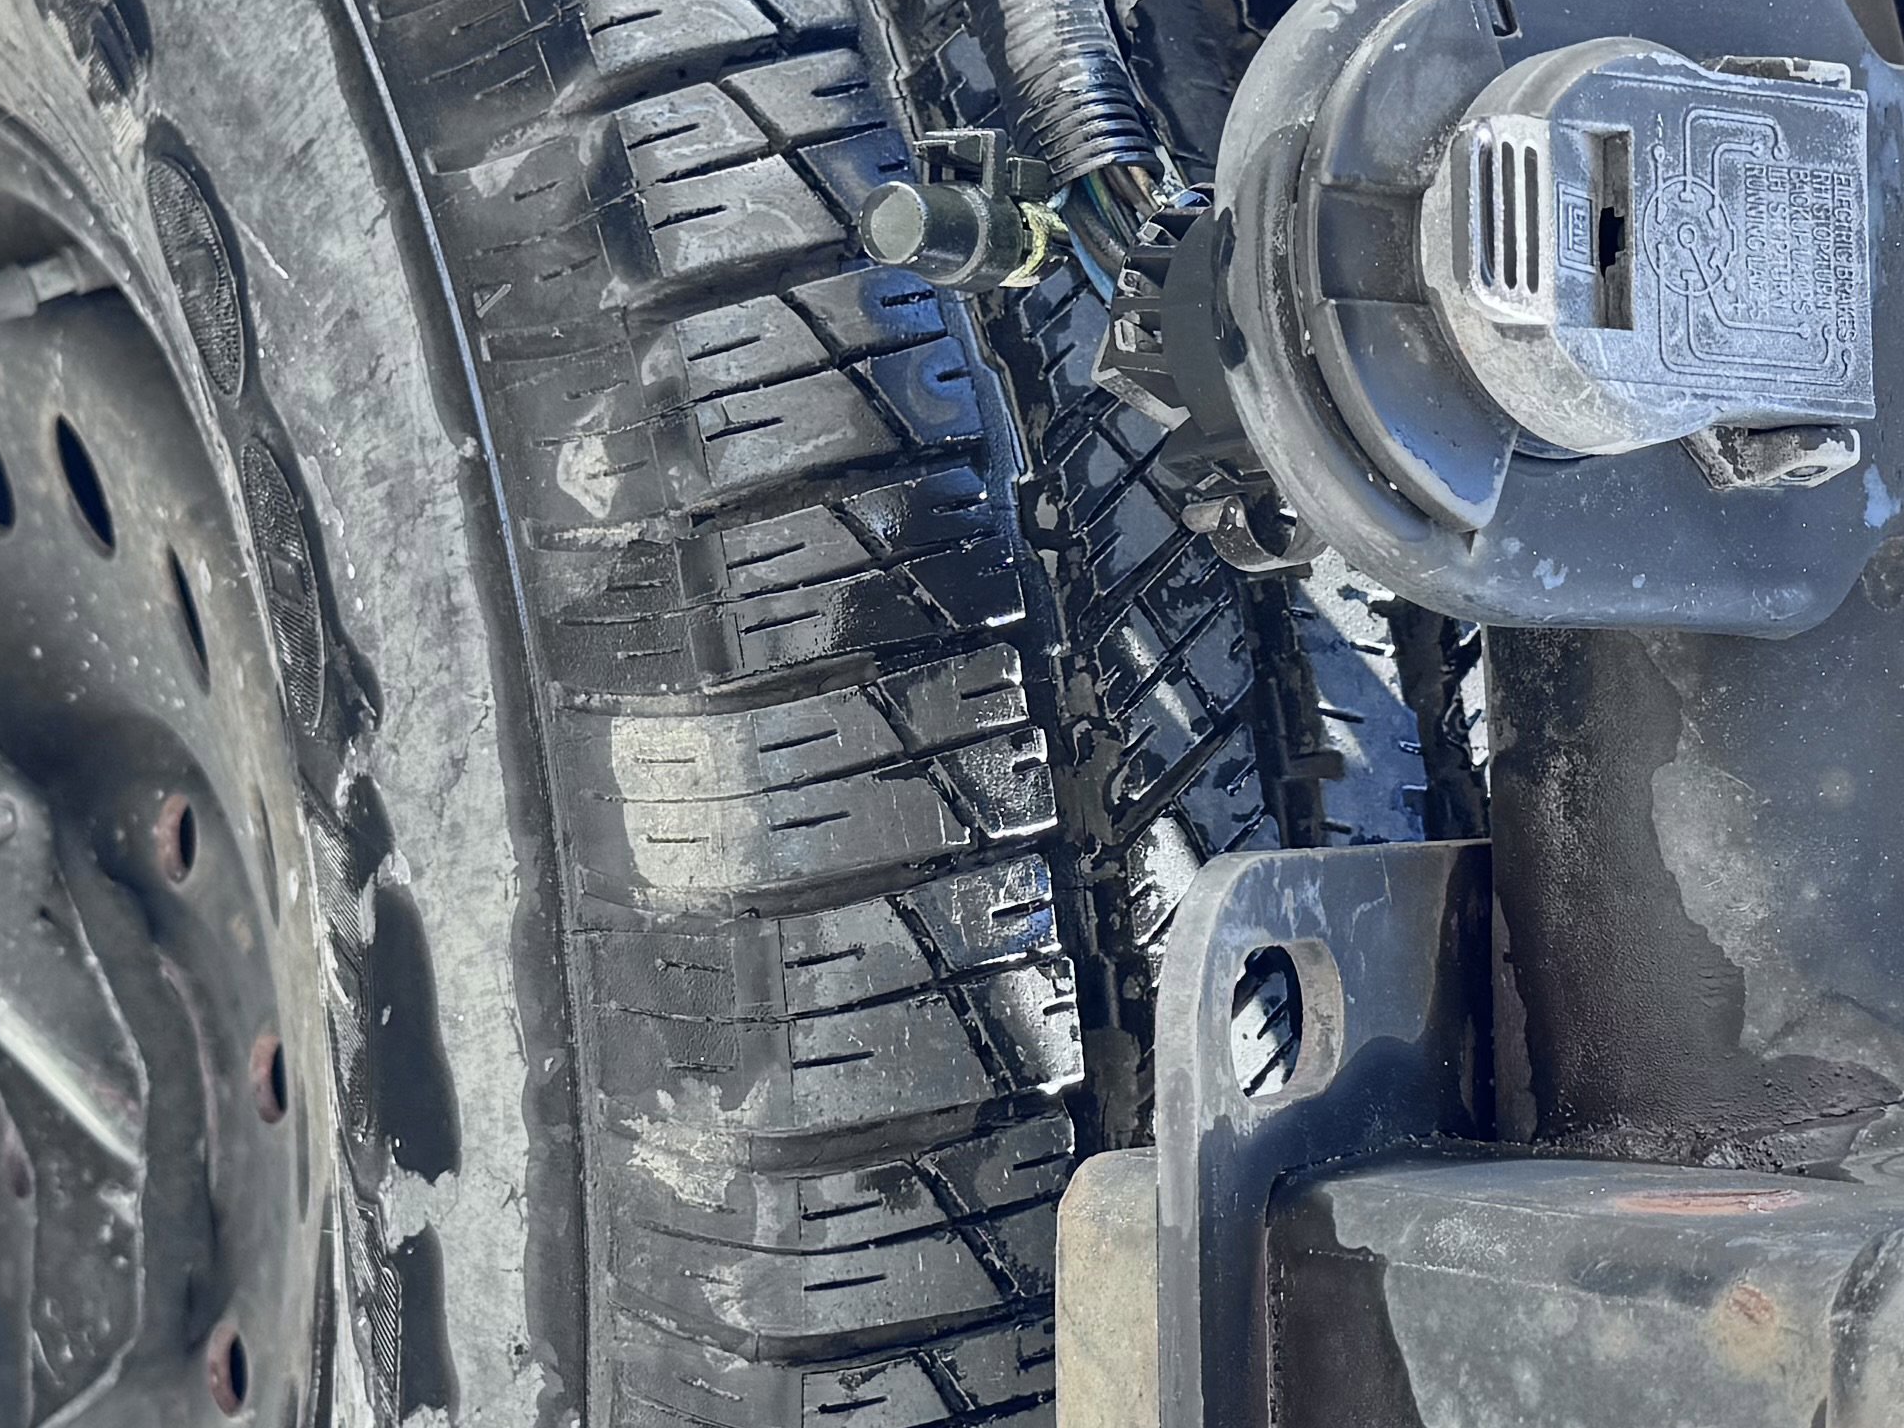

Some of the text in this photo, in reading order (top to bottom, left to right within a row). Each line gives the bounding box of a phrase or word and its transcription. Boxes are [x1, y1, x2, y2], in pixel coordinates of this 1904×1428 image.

[1744, 163, 1766, 251] RUNNING
[1766, 165, 1787, 191] LH
[1788, 168, 1812, 315] BACKUP LAMPS
[1810, 170, 1833, 311] RH STOP/TURN
[1831, 172, 1856, 343] ELECTRIC BRAKES
